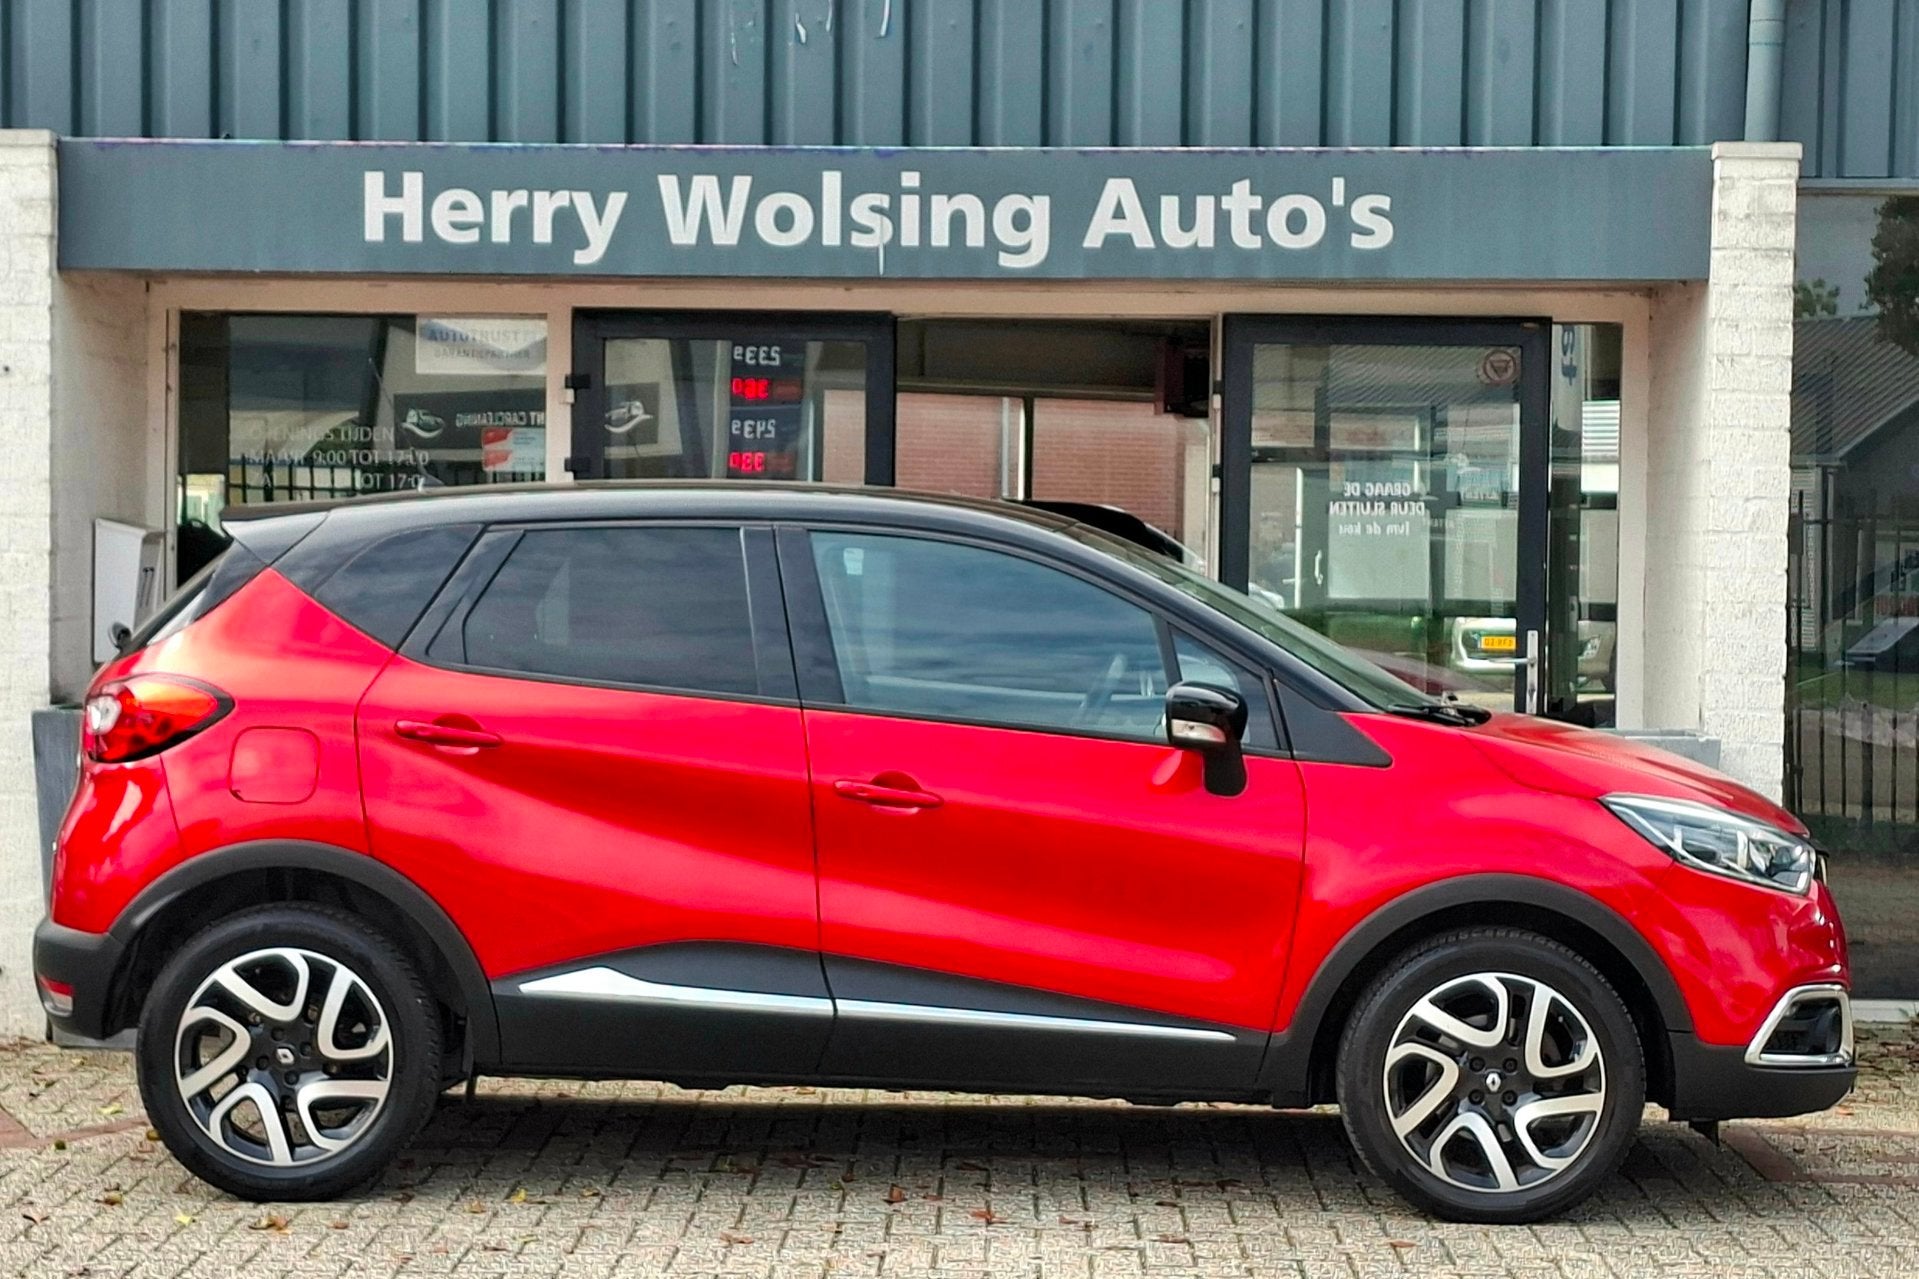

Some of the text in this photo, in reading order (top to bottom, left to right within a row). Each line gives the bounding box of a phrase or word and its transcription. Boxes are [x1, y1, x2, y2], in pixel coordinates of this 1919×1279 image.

[364, 171, 1394, 269] Herry Wolsing Auto's
[349, 449, 379, 466] TOT
